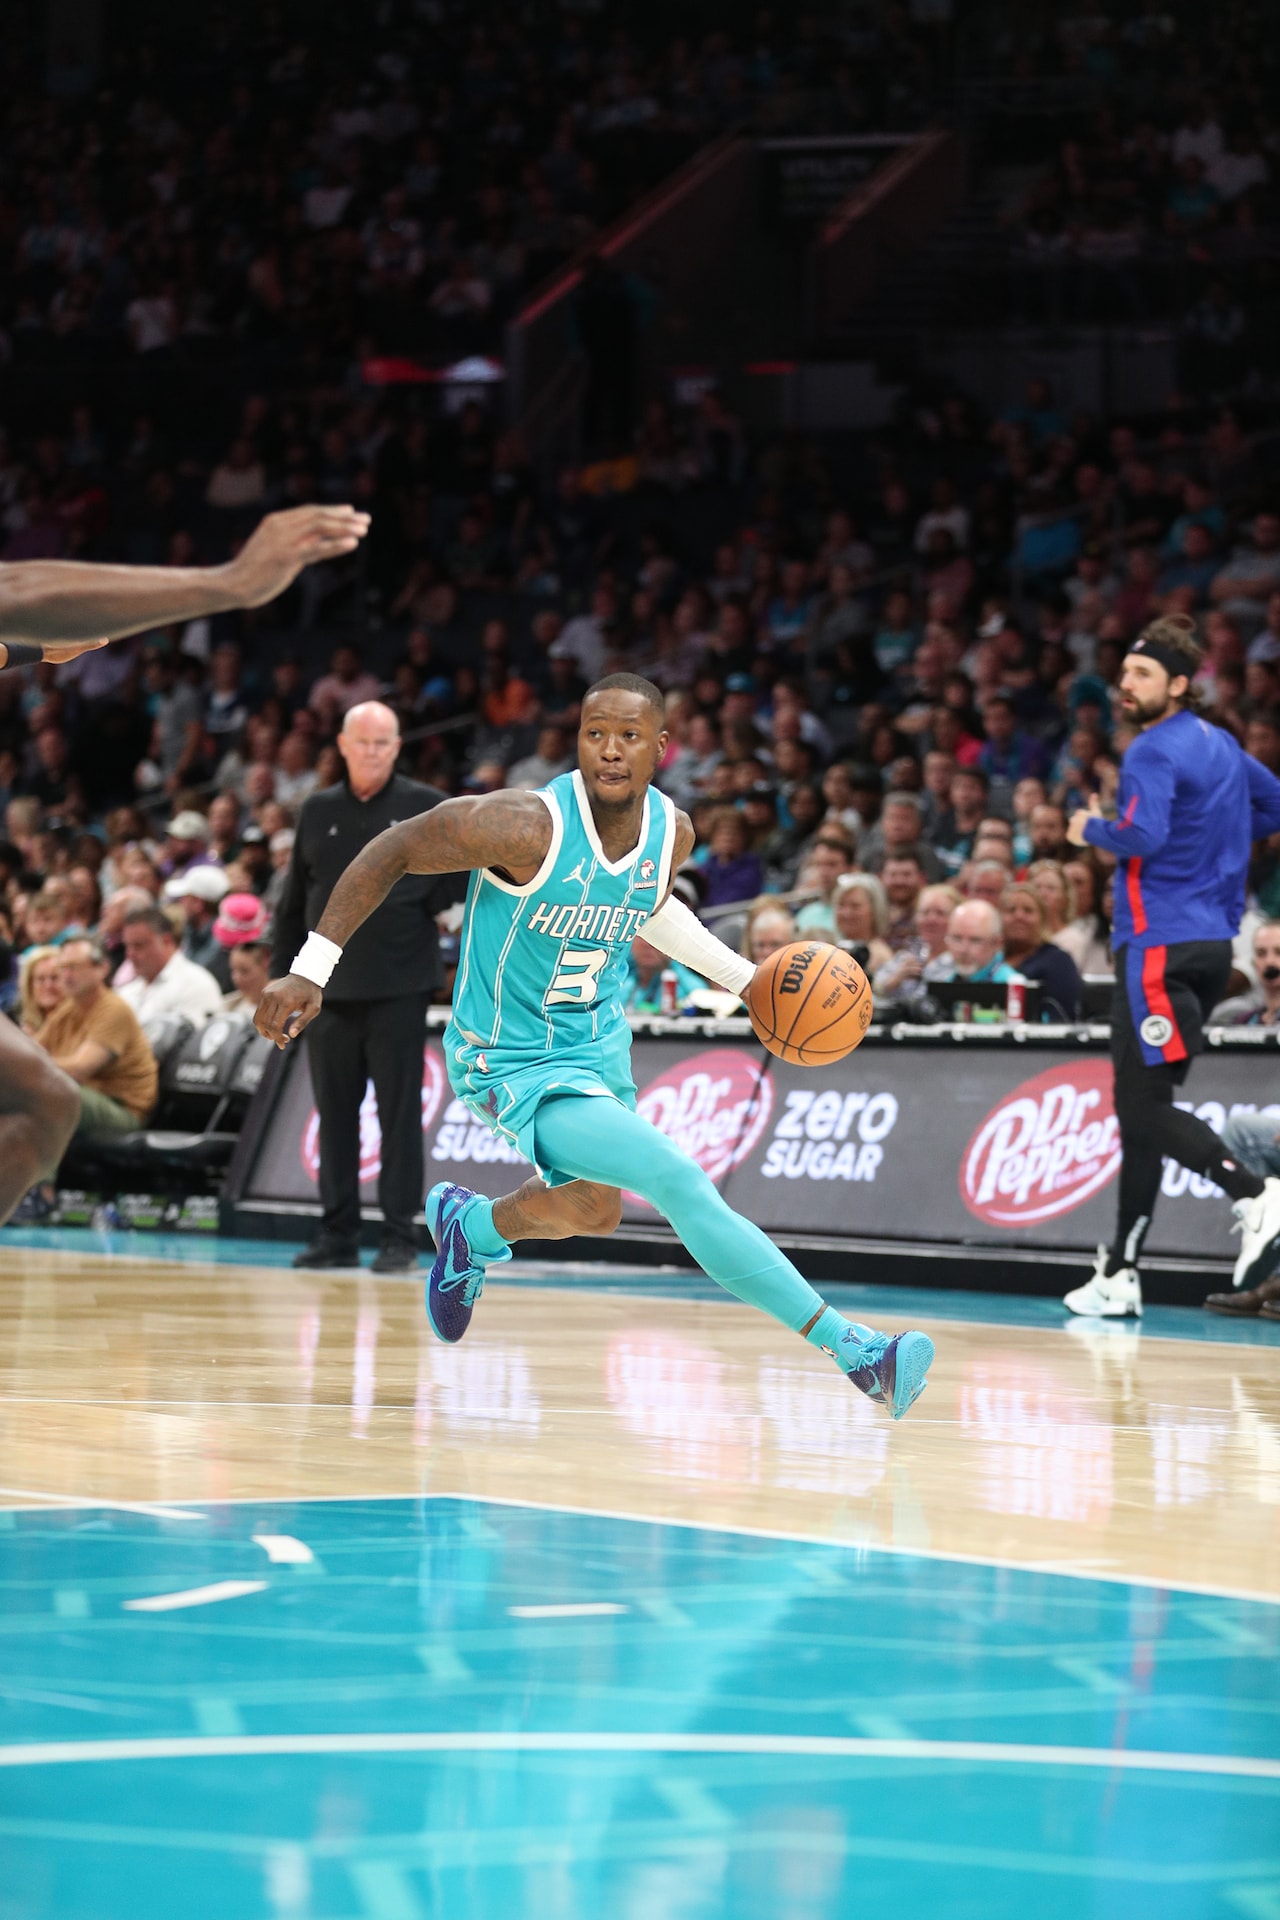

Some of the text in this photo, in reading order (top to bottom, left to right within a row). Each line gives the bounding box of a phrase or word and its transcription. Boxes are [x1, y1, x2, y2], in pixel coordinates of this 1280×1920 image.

[528, 901, 648, 942] HORNETS
[545, 947, 608, 1006] 3
[774, 1090, 899, 1143] zero
[1031, 1083, 1101, 1147] Dr
[431, 1123, 533, 1165] SUGA
[761, 1140, 884, 1182] SUGAR
[966, 1097, 1119, 1205] Pepper
